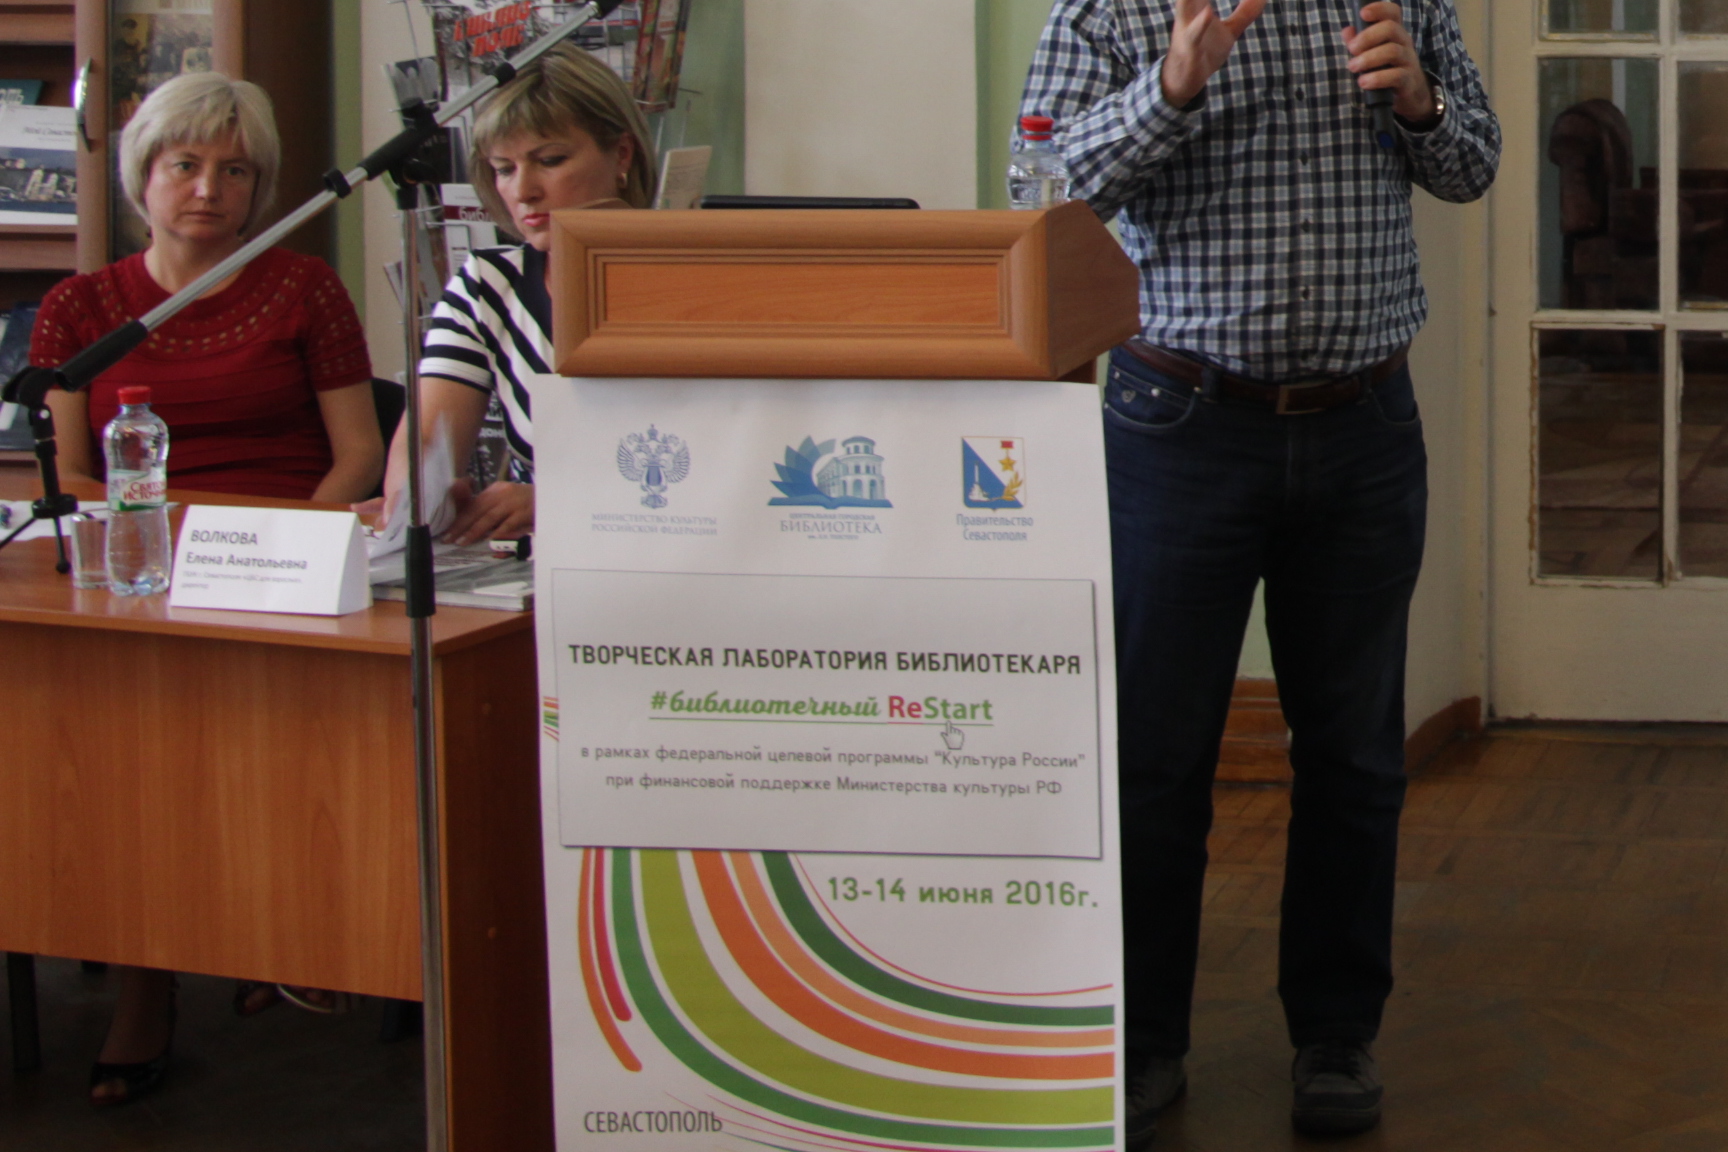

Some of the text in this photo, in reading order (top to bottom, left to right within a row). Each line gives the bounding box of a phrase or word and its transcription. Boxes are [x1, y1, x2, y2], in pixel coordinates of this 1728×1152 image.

[591, 513, 668, 523] МИНИСТЕРСТВО
[780, 520, 882, 534] БИБЛИОТЕКА
[956, 513, 1034, 528] Правительство
[190, 529, 258, 545] ВОЛКОВА
[963, 528, 1028, 541] Севастополя
[186, 551, 308, 570] Елена Анатольевна
[568, 644, 1081, 675] ТВОРЧЕСКАЯ ЛАБОРАТОРИЯ БИБЛИОТЕКАРЯ
[651, 690, 994, 720] #библиотечный ReStart
[581, 747, 590, 757] в
[595, 747, 649, 760] рамках
[656, 745, 762, 762] федеральной
[768, 746, 832, 763] целевой
[838, 751, 929, 766] программы
[606, 772, 1063, 797] при финансовой поддержке Министерства культуры РФ
[828, 876, 1098, 908] 13-14 июня 2016г.
[583, 1110, 723, 1133] СЕВАСТОПОЛЬ
